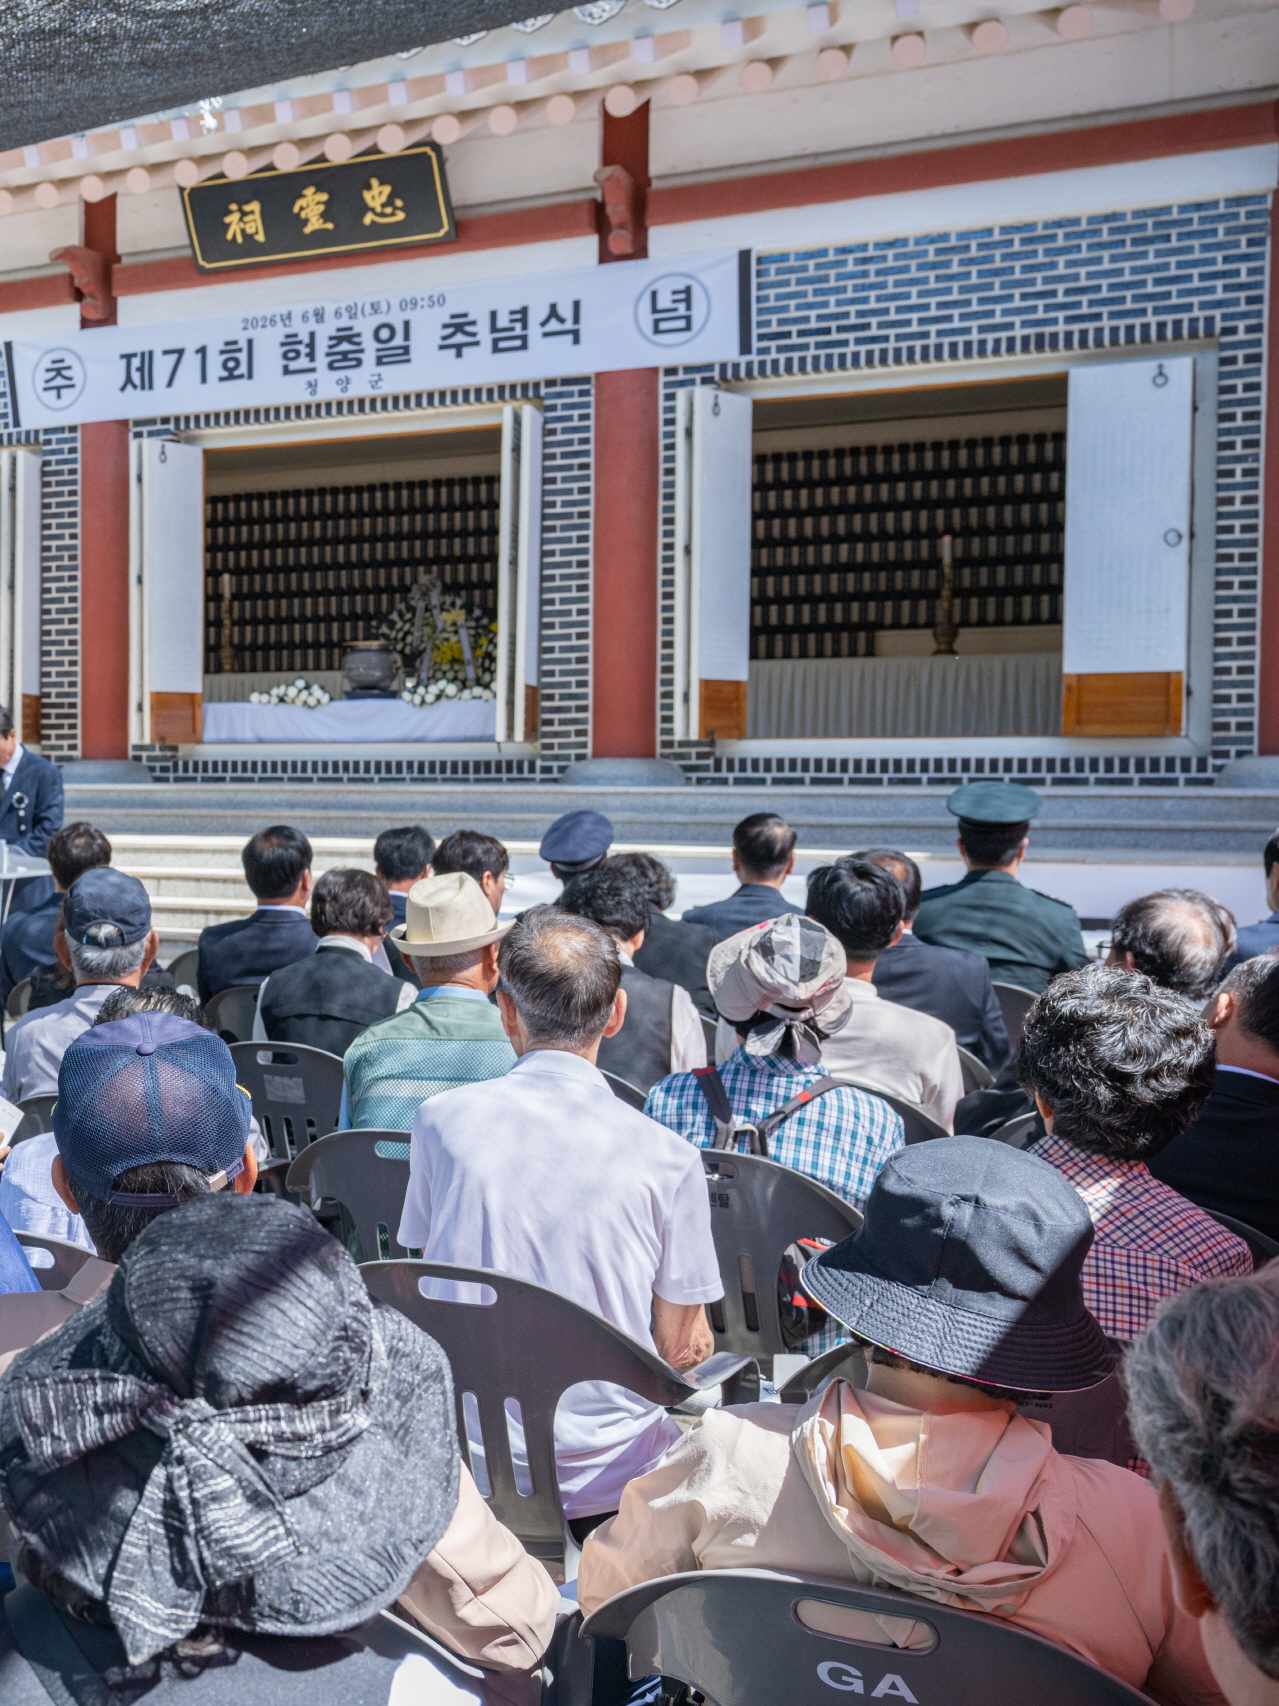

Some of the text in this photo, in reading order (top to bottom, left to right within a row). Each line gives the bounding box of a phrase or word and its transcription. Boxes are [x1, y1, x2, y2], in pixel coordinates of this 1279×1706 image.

[241, 293, 447, 331] 2026년 6월 6일(토) 09:50
[650, 284, 694, 334] 념
[119, 298, 583, 393] 제71회 현충일 추념식
[42, 357, 77, 400] 추
[816, 1661, 919, 1704] GA
